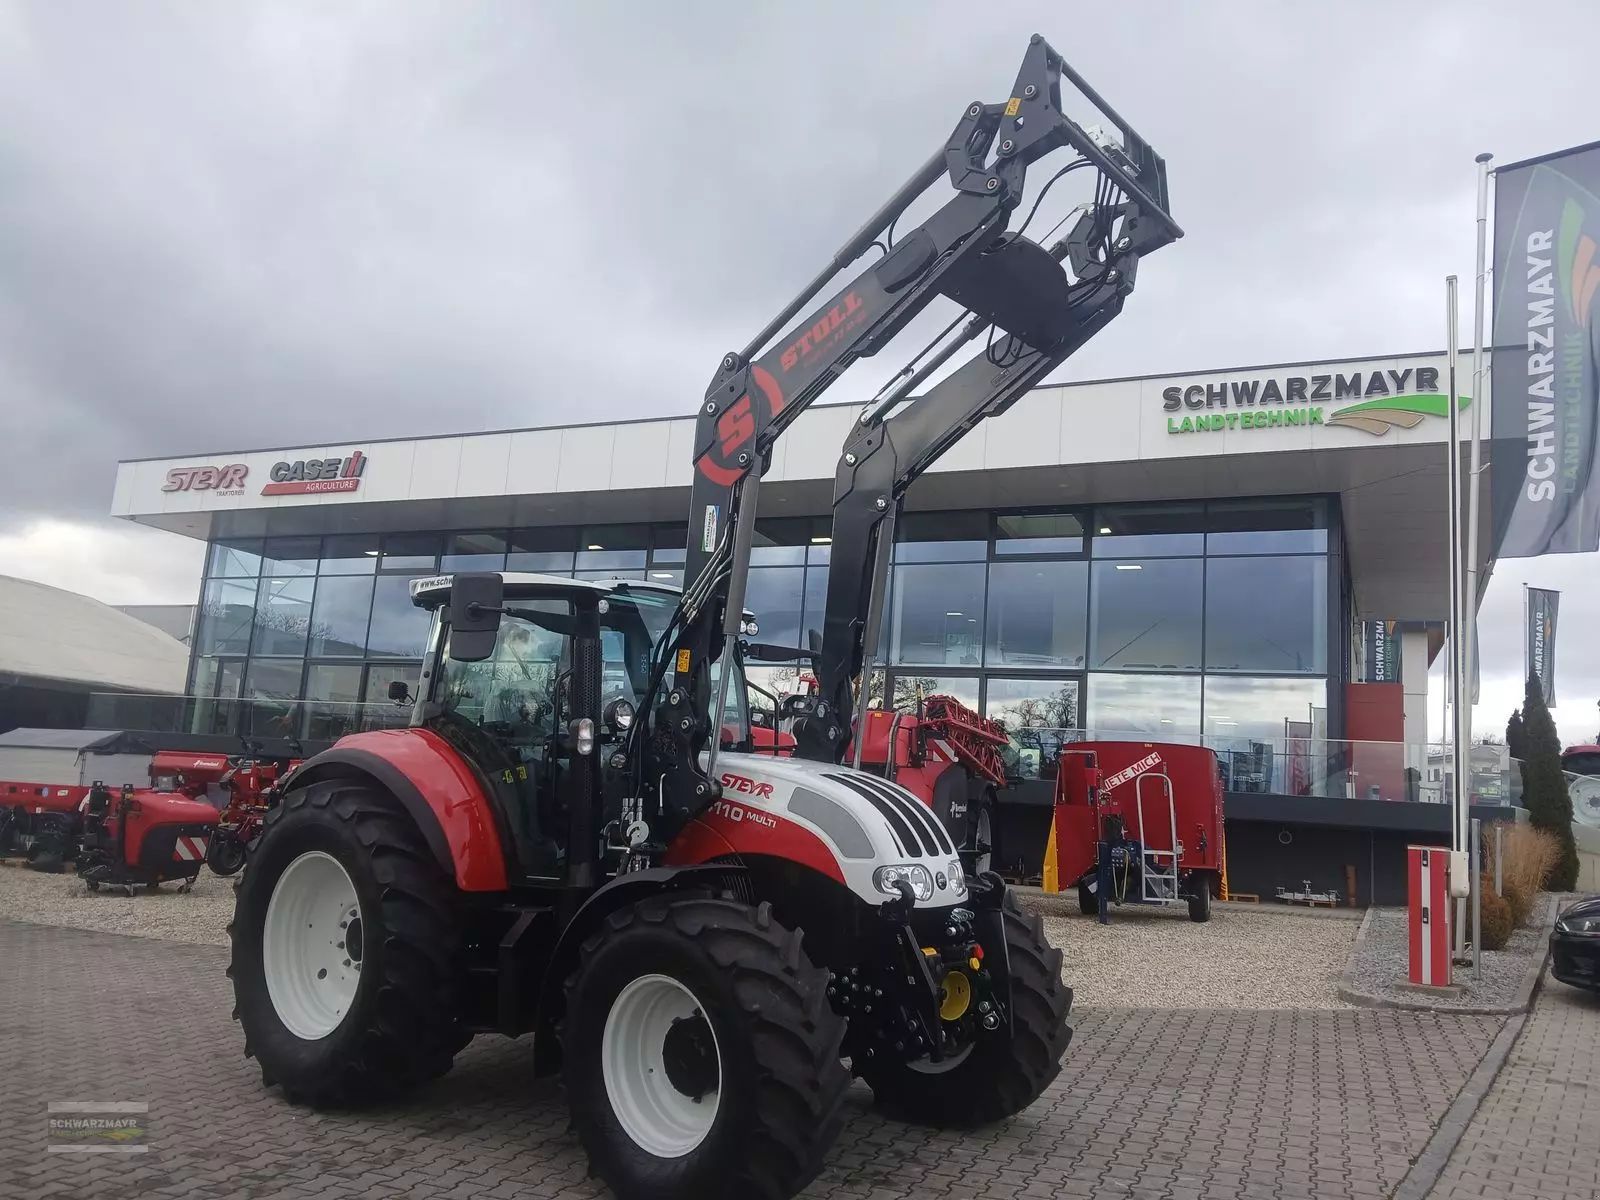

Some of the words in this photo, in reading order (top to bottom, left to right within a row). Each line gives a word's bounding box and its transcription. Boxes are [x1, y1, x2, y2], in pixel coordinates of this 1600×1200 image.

[780, 291, 863, 373] STOLL
[1526, 229, 1556, 502] SCHWARZMAYR
[1162, 366, 1441, 412] SCHWARZMAYR
[1167, 406, 1324, 434] LANDTECHNIK
[1562, 331, 1585, 495] LANDTECHNIK
[161, 464, 248, 492] STEYR
[269, 458, 342, 482] CASE
[305, 480, 354, 492] AGRICULTURE
[1104, 770, 1131, 791] IETE
[1130, 752, 1161, 776] MICH
[721, 773, 774, 800] STEYR
[708, 801, 744, 822] 110
[746, 811, 777, 829] MULTI
